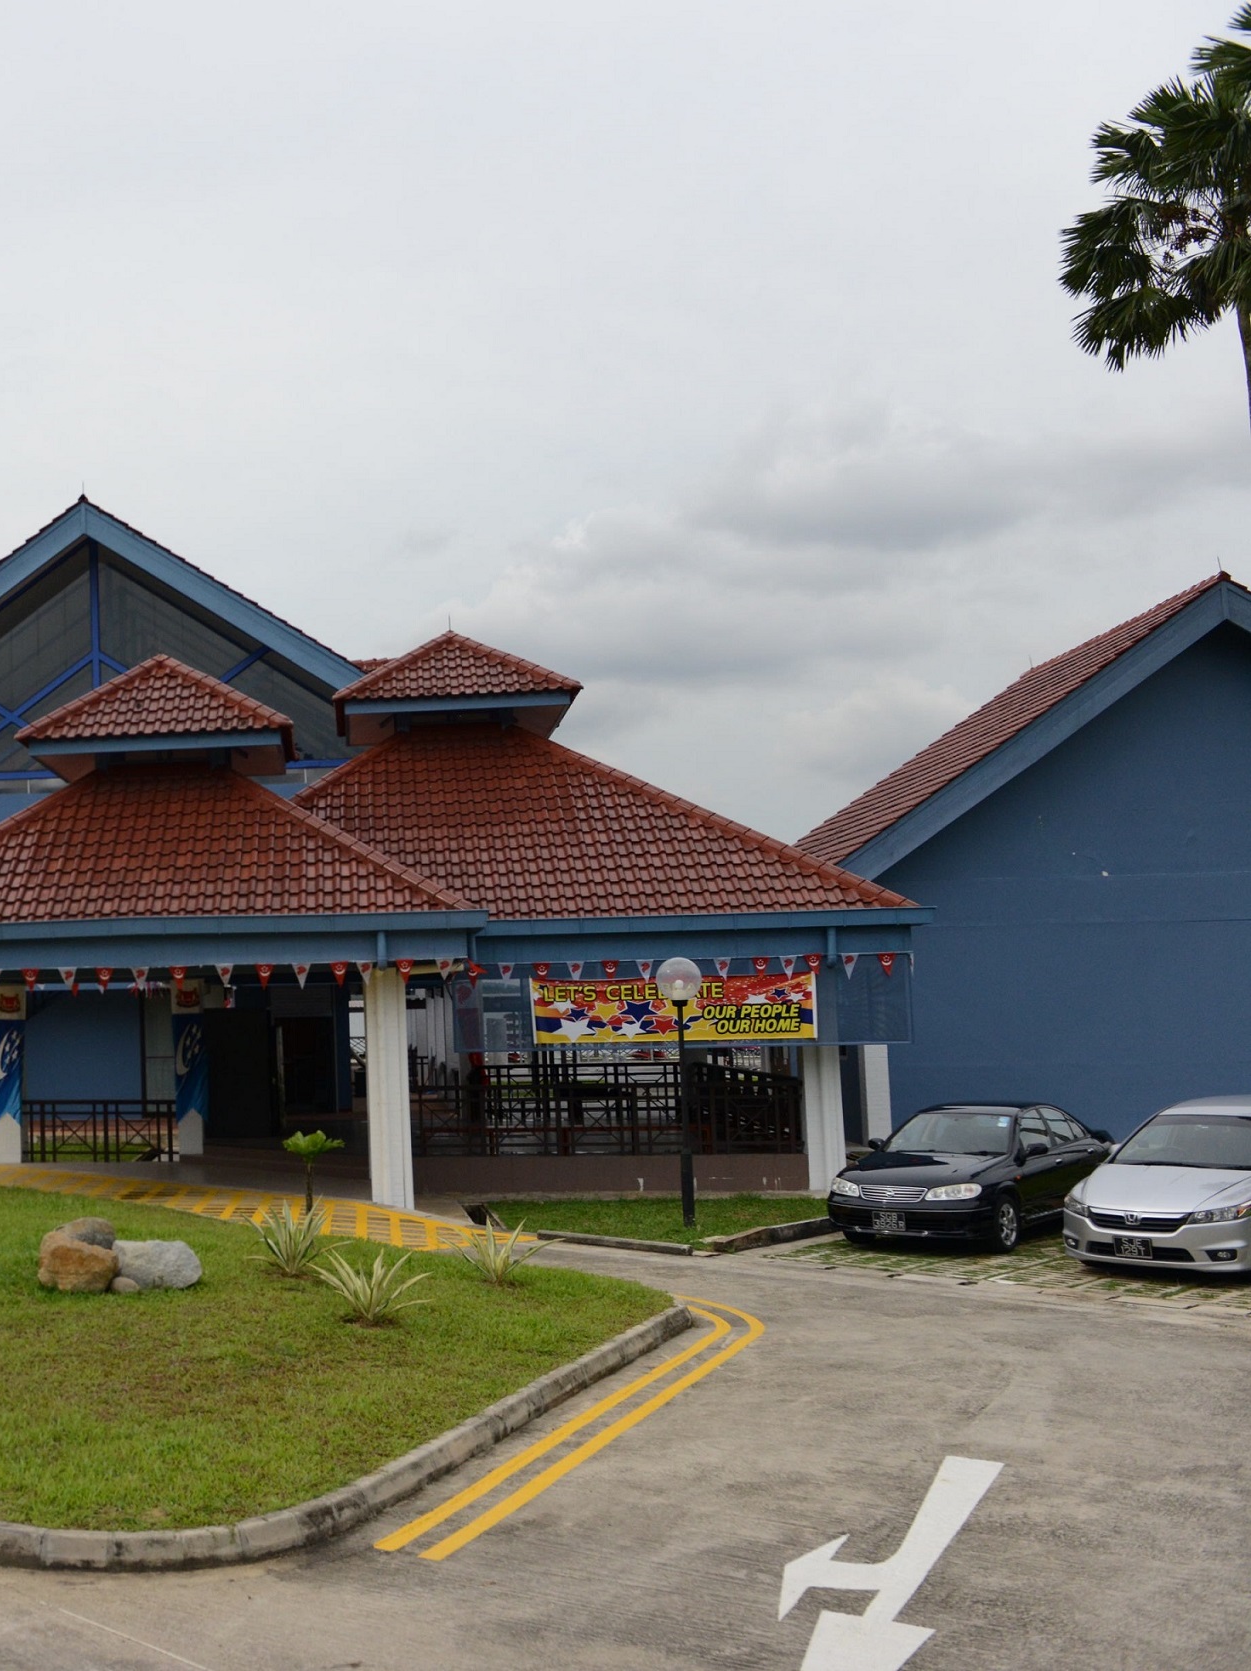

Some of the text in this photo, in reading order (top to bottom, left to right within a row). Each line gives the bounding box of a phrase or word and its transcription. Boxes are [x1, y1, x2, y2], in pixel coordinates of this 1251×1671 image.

[544, 982, 724, 1002] LET'S CELEBATE
[703, 1003, 800, 1019] OUR PEOPLE
[716, 1018, 801, 1033] OUR HOME
[1120, 1246, 1146, 1256] 129T
